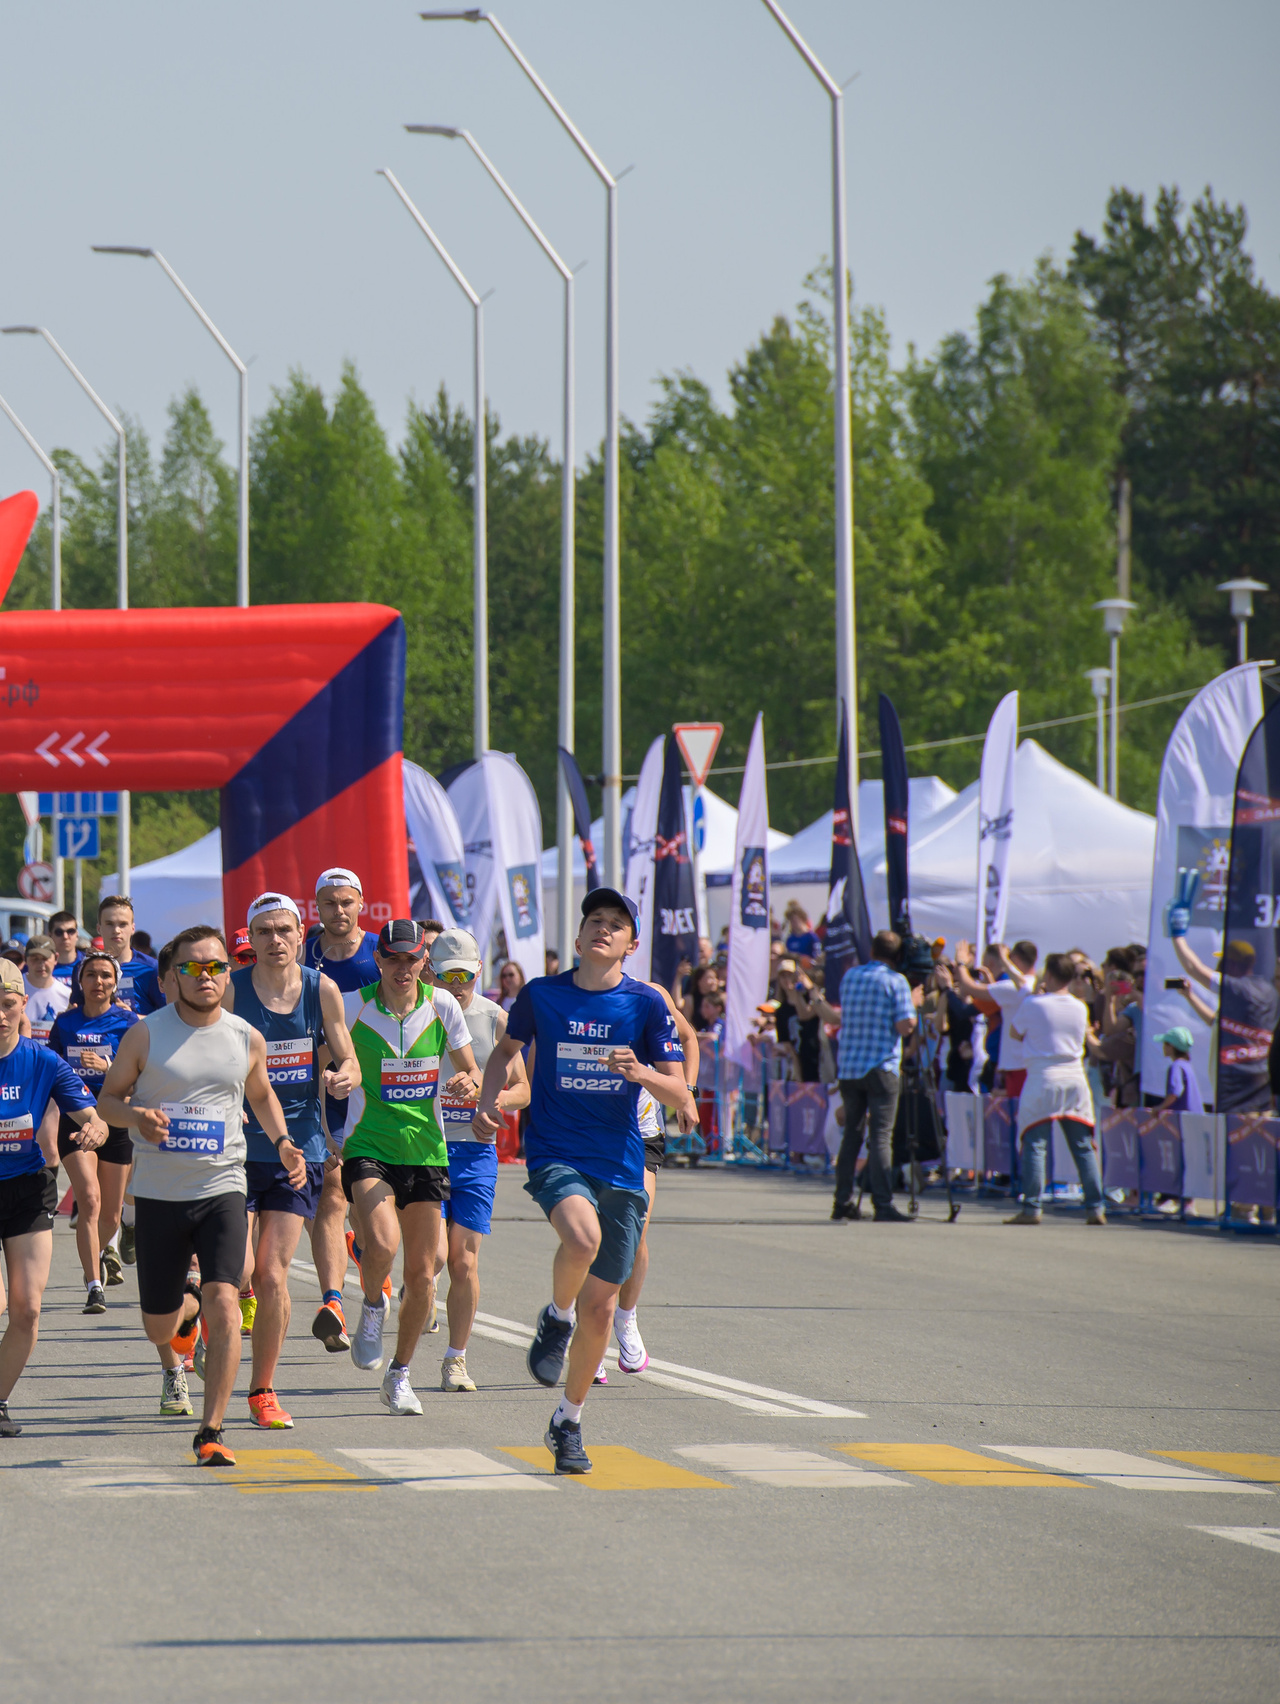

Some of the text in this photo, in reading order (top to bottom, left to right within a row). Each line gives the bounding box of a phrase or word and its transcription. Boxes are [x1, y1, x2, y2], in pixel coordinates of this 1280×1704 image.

[267, 1068, 308, 1083] 0075
[560, 1076, 624, 1091] 50227
[386, 1085, 434, 1099] 10097
[165, 1136, 219, 1151] 50176
